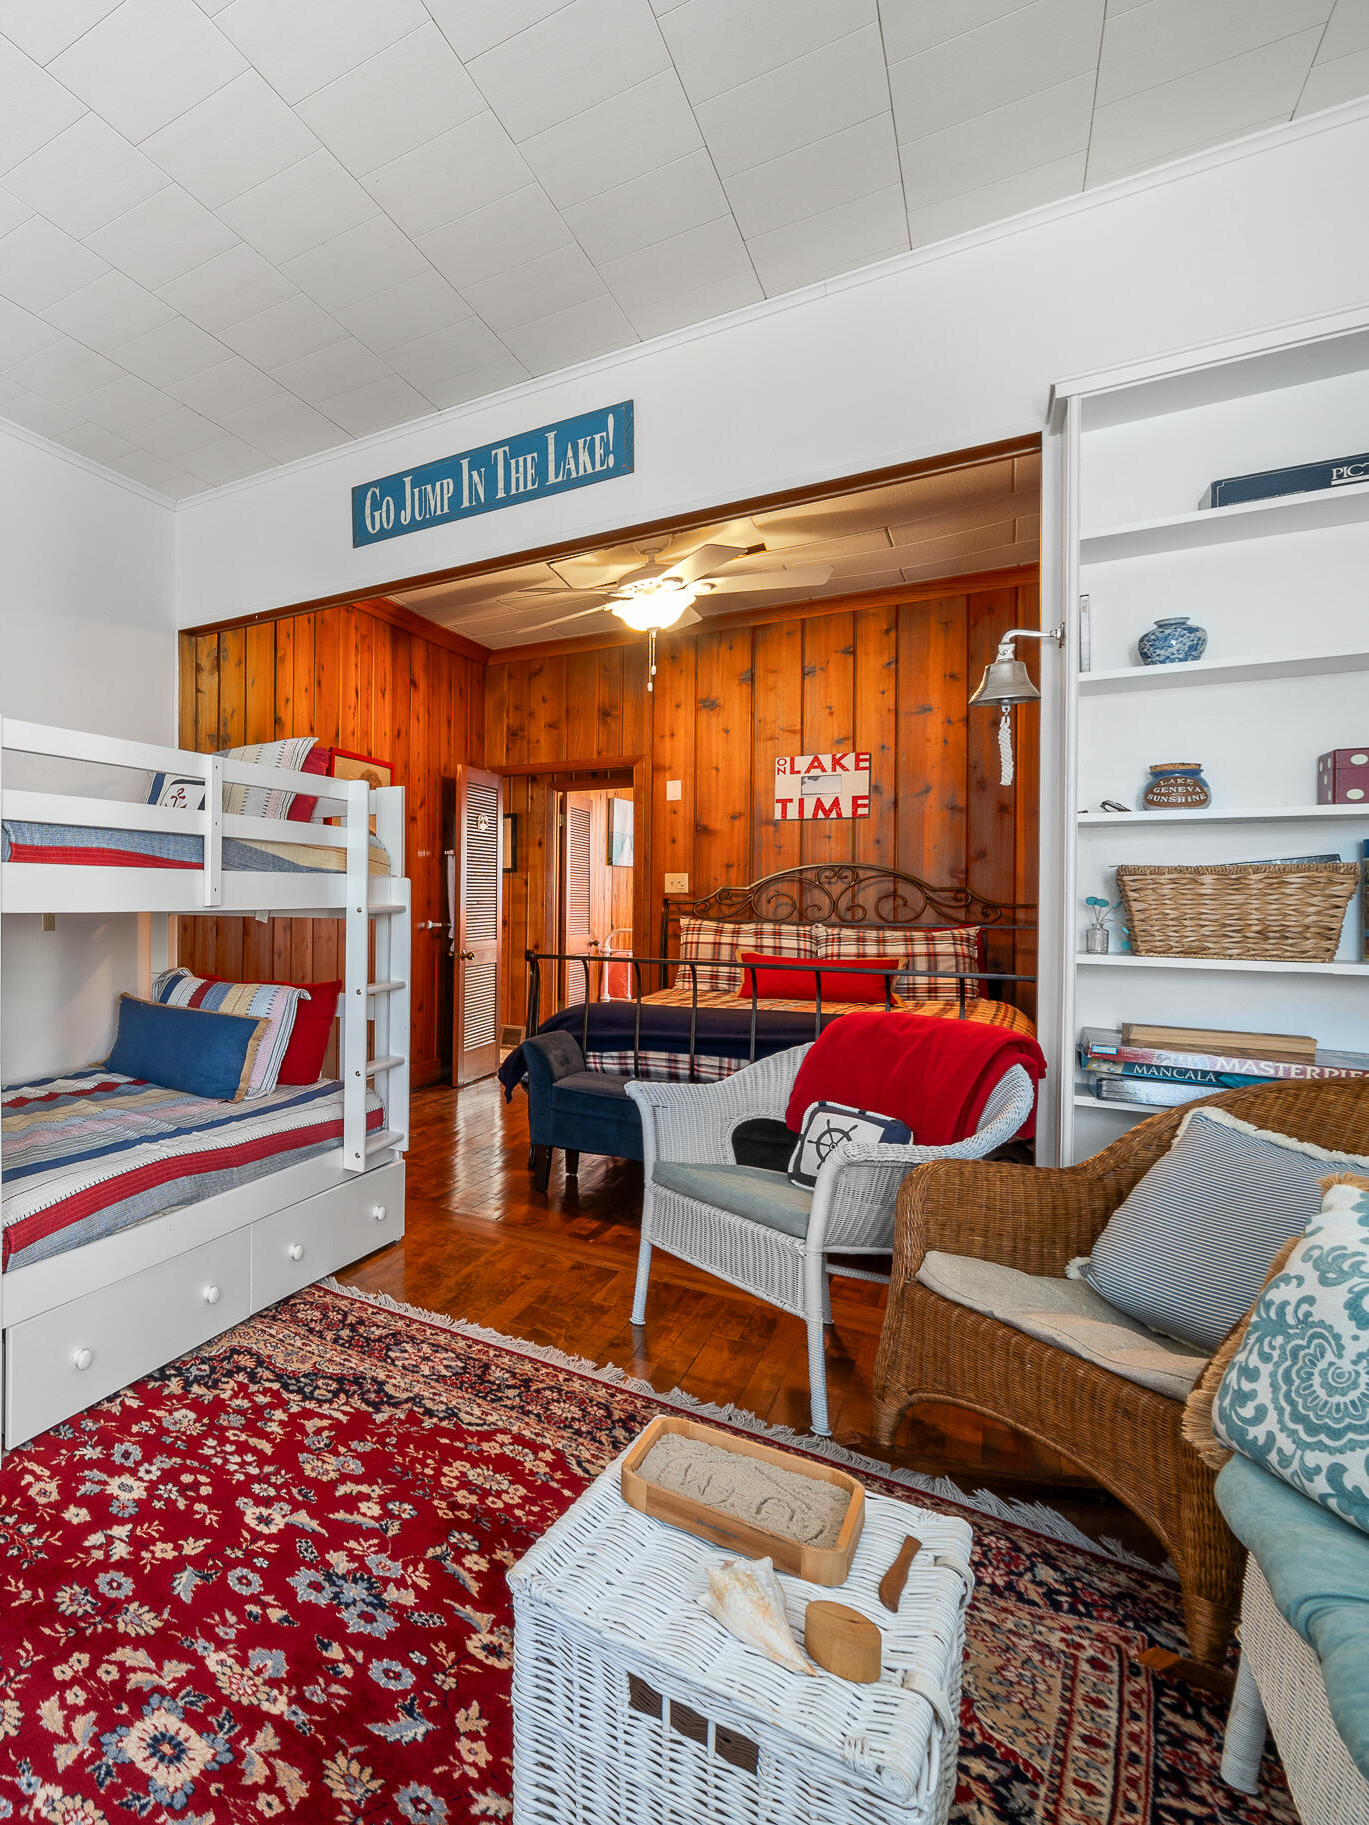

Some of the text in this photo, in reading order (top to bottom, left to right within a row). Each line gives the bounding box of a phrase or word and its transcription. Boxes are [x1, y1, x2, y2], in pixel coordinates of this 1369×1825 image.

[776, 752, 870, 776] ON LAKE
[1159, 778, 1194, 786] LAKE
[775, 795, 869, 820] TIME
[1146, 793, 1207, 803] SUNSHINE
[1133, 1064, 1216, 1082] MANCALA
[1216, 1056, 1369, 1080] MASTERPIE
